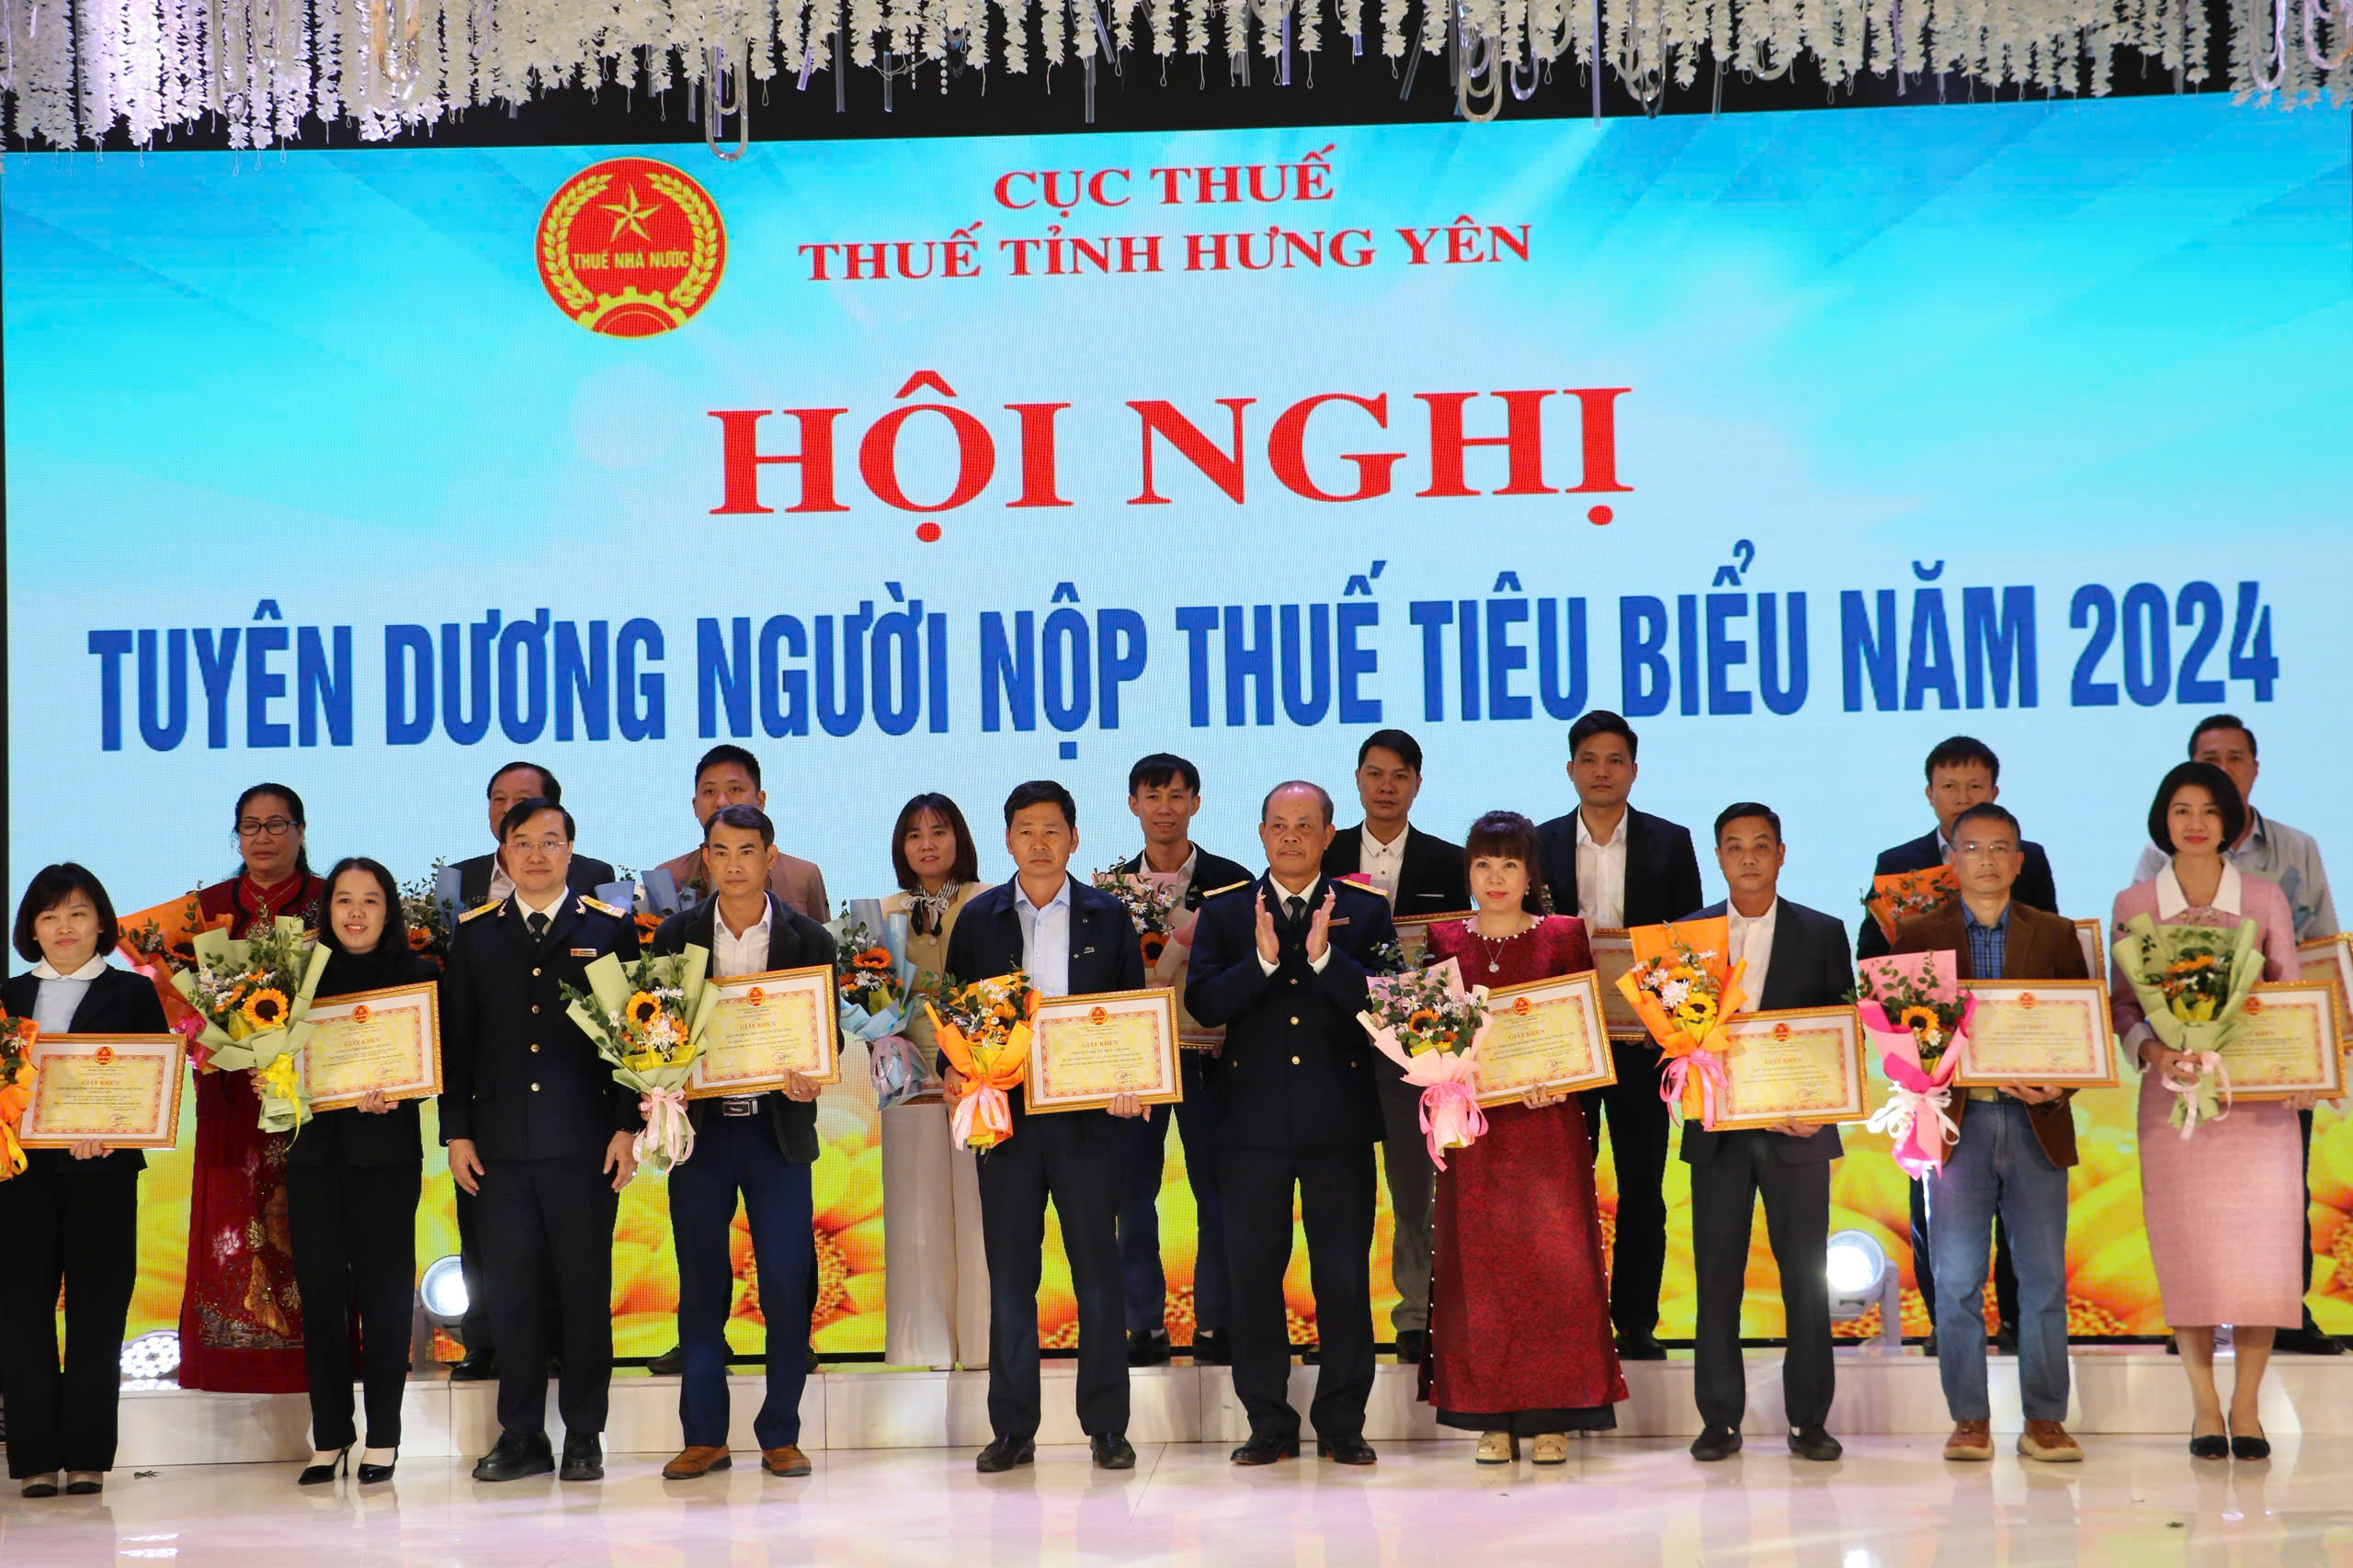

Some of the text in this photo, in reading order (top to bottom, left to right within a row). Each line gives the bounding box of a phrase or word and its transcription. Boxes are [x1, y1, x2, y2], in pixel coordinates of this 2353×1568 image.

[993, 143, 1336, 219] CỤC THUẾ
[573, 245, 690, 269] THUẾ NHÀ NƯỚC
[799, 213, 1532, 281] THUẾ TỈNH HƯNG YÊN
[709, 369, 1635, 542] HỘI NGHỊ
[87, 539, 2279, 760] TUYÊN DƯƠNG NGƯỜI NỘP THUẾ TIÊU BIỂU NĂM 2024
